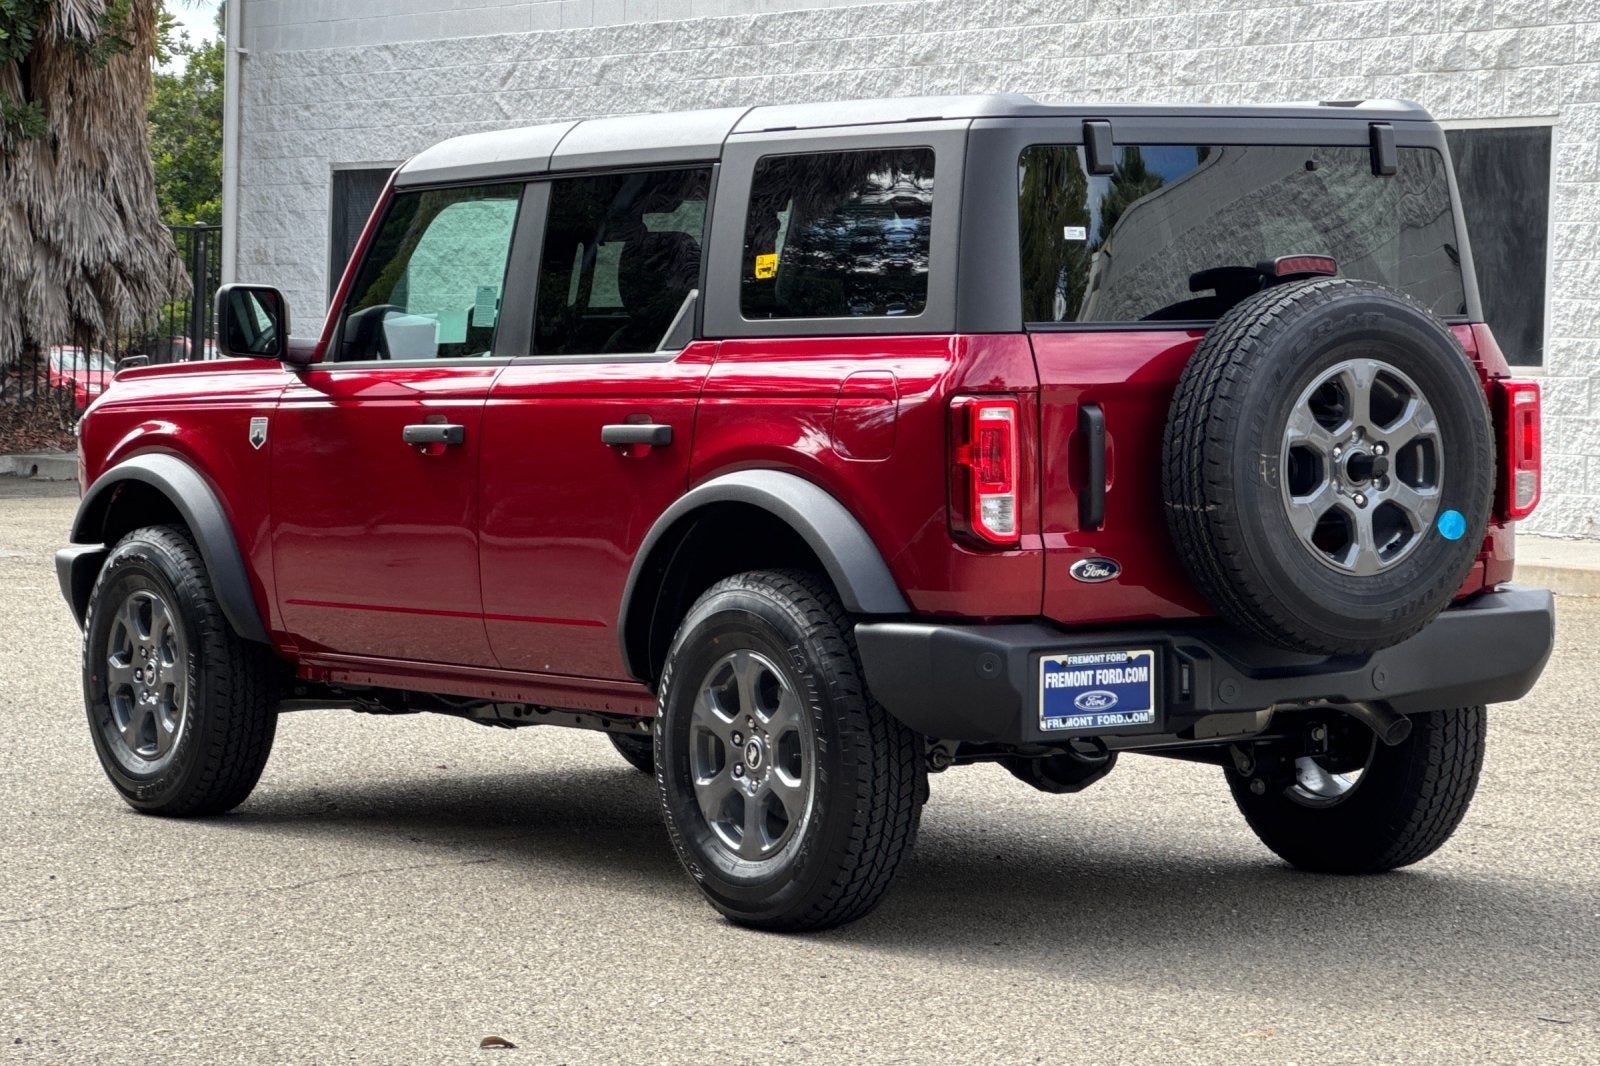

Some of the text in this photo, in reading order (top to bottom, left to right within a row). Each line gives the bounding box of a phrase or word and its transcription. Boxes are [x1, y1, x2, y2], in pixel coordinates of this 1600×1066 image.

[1082, 563, 1109, 577] Ford
[1068, 653, 1127, 664] FREMONT FORD
[1045, 667, 1148, 688] FREMONT FORD.COM
[1085, 695, 1106, 706] Ford
